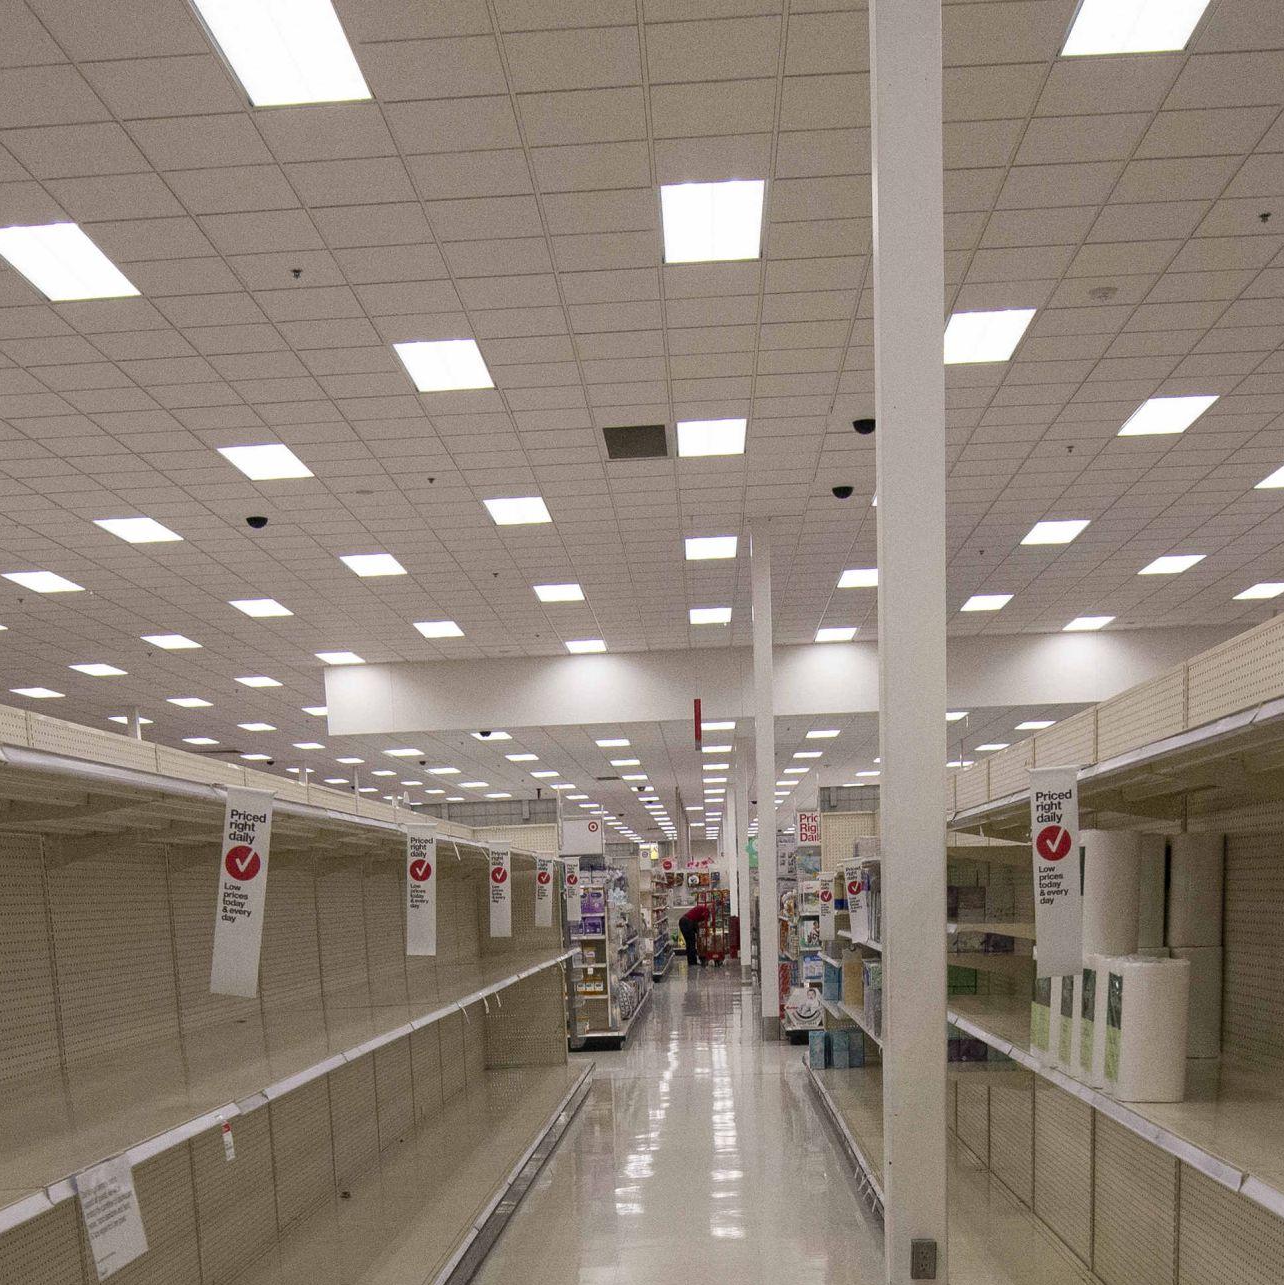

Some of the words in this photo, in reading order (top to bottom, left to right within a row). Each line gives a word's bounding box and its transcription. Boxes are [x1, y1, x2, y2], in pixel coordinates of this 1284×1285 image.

[1035, 789, 1072, 802] Priced
[1036, 801, 1062, 813] right
[230, 809, 267, 823] Priced
[1037, 812, 1063, 824] daily
[229, 820, 256, 832] right
[228, 831, 255, 845] daily
[410, 850, 427, 858] daily
[1039, 872, 1063, 881] prices
[224, 882, 241, 891] Low
[1039, 880, 1061, 889] today
[223, 890, 248, 900] prices
[1047, 888, 1069, 896] every
[223, 898, 245, 908] today
[1040, 897, 1054, 905] day
[229, 908, 252, 917] every
[221, 914, 236, 923] day
